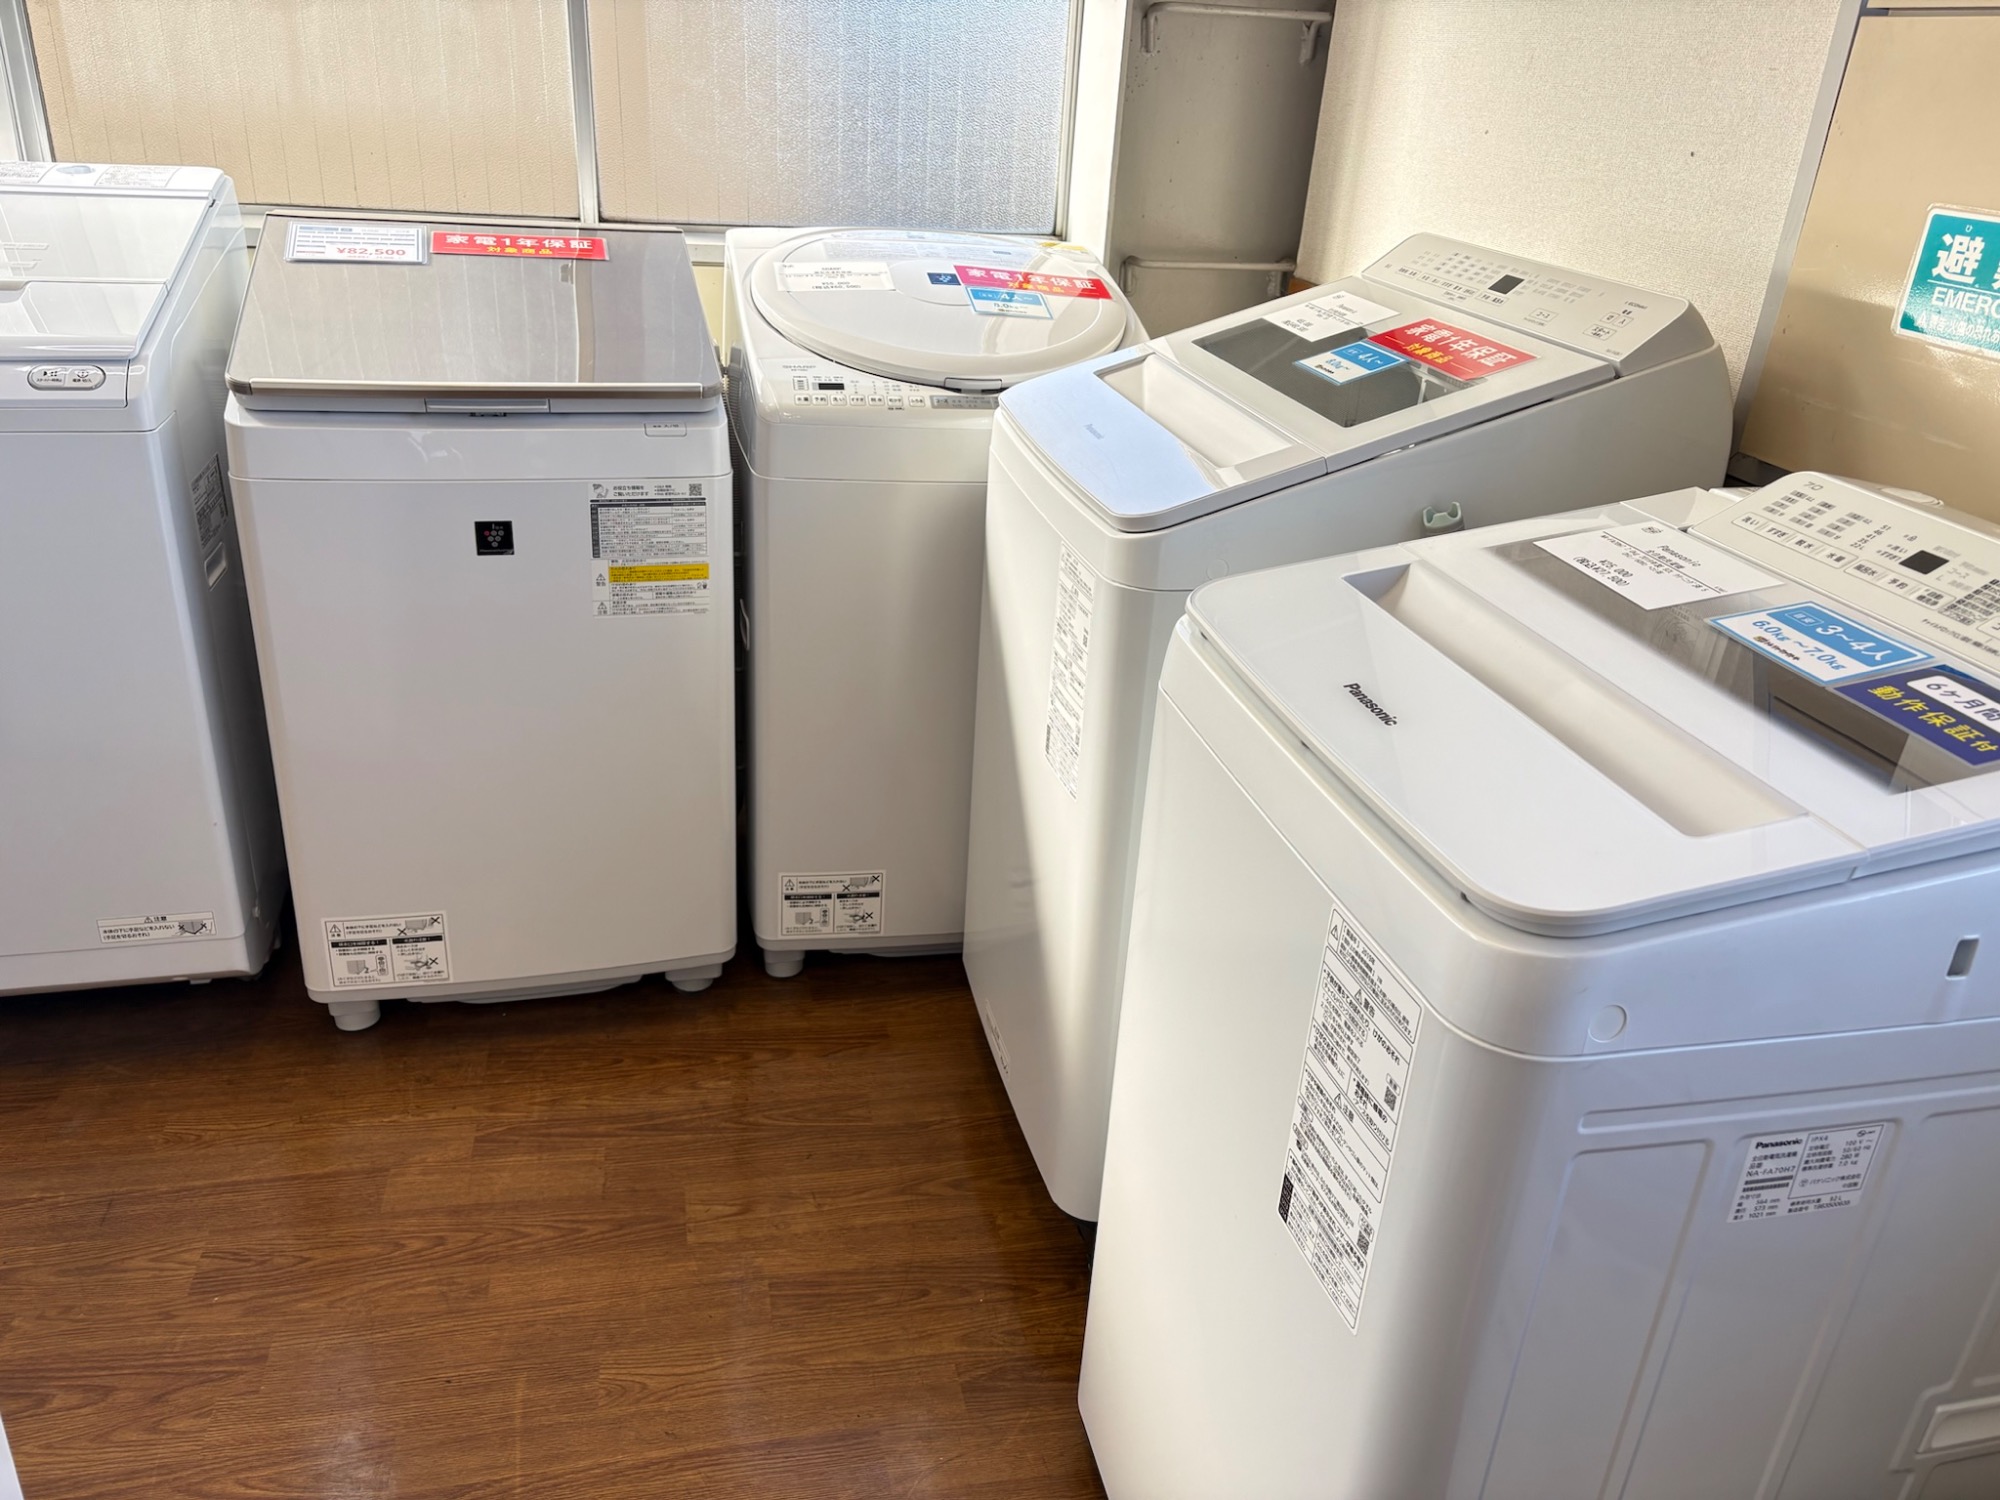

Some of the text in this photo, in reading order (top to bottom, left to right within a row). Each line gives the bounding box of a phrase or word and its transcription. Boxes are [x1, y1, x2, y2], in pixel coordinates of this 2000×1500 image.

[445, 235, 593, 249] 家電1年保証
[336, 247, 406, 256] ¥82,500
[487, 246, 552, 255] 対象商品
[966, 268, 1097, 290] 家電1年保証
[1404, 323, 1518, 367] 家電1年保証
[1740, 517, 1760, 526] 洗い
[1766, 527, 1788, 538] すすぎ
[1794, 539, 1814, 550] 脱水
[1594, 559, 1637, 578] ¥25,000
[1888, 578, 1908, 591] 予約
[1343, 682, 1398, 726] Panasonic
[1868, 685, 1998, 753] 動作保証付
[1362, 996, 1375, 1019] 警告
[1342, 1101, 1354, 1124] 注意
[1755, 1137, 1803, 1149] Panasonic
